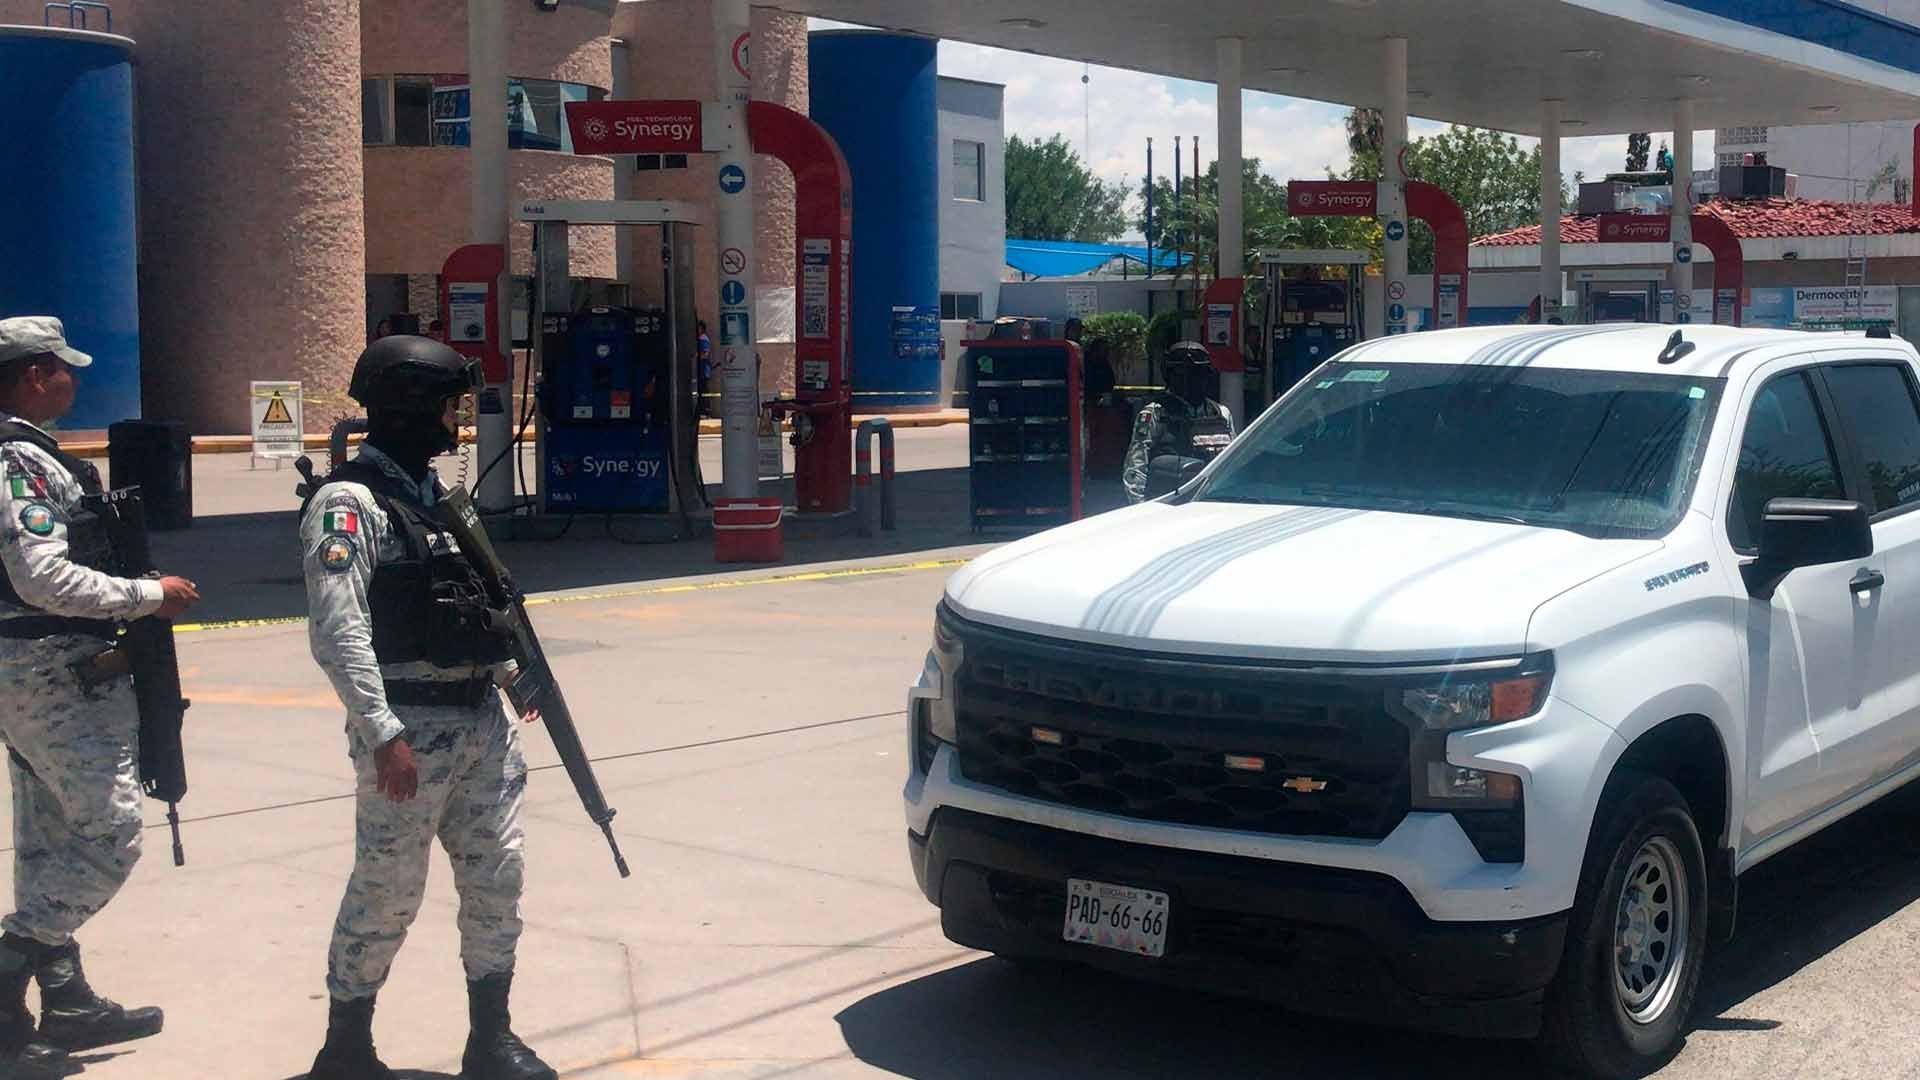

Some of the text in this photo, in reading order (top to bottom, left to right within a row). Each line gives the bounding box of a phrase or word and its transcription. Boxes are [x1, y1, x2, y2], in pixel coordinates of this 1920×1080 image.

[614, 120, 694, 141] Synergy
[1319, 193, 1372, 208] Synergy
[1623, 224, 1665, 237] Synergy
[1068, 894, 1163, 936] PAD-66-66
